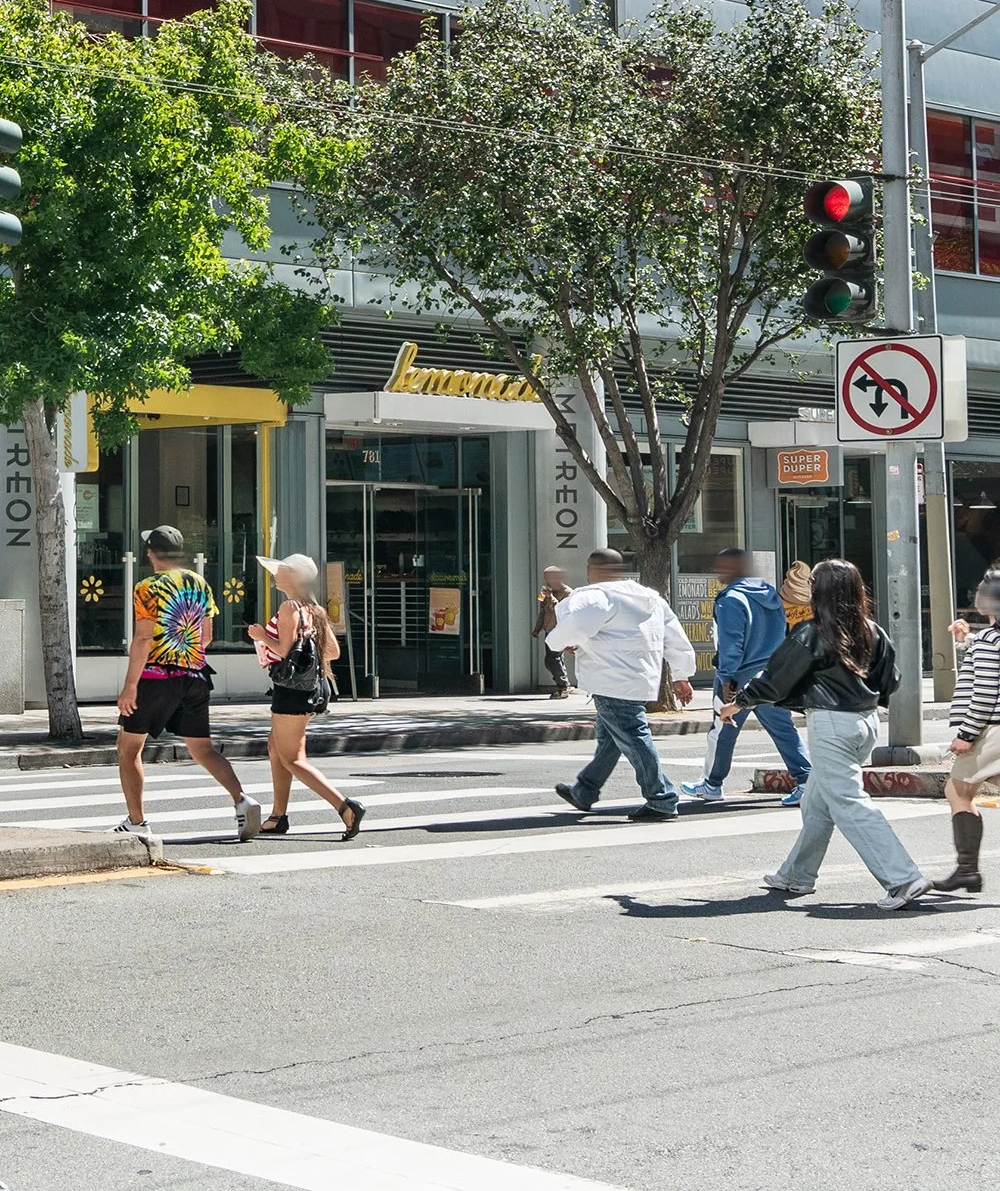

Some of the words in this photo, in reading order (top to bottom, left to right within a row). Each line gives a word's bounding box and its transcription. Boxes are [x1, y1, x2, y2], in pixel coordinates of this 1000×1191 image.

[798, 407, 835, 422] SUPE
[362, 450, 380, 464] 781
[783, 454, 821, 464] SUPER
[783, 463, 821, 473] DUPER
[678, 583, 708, 597] EMONADE
